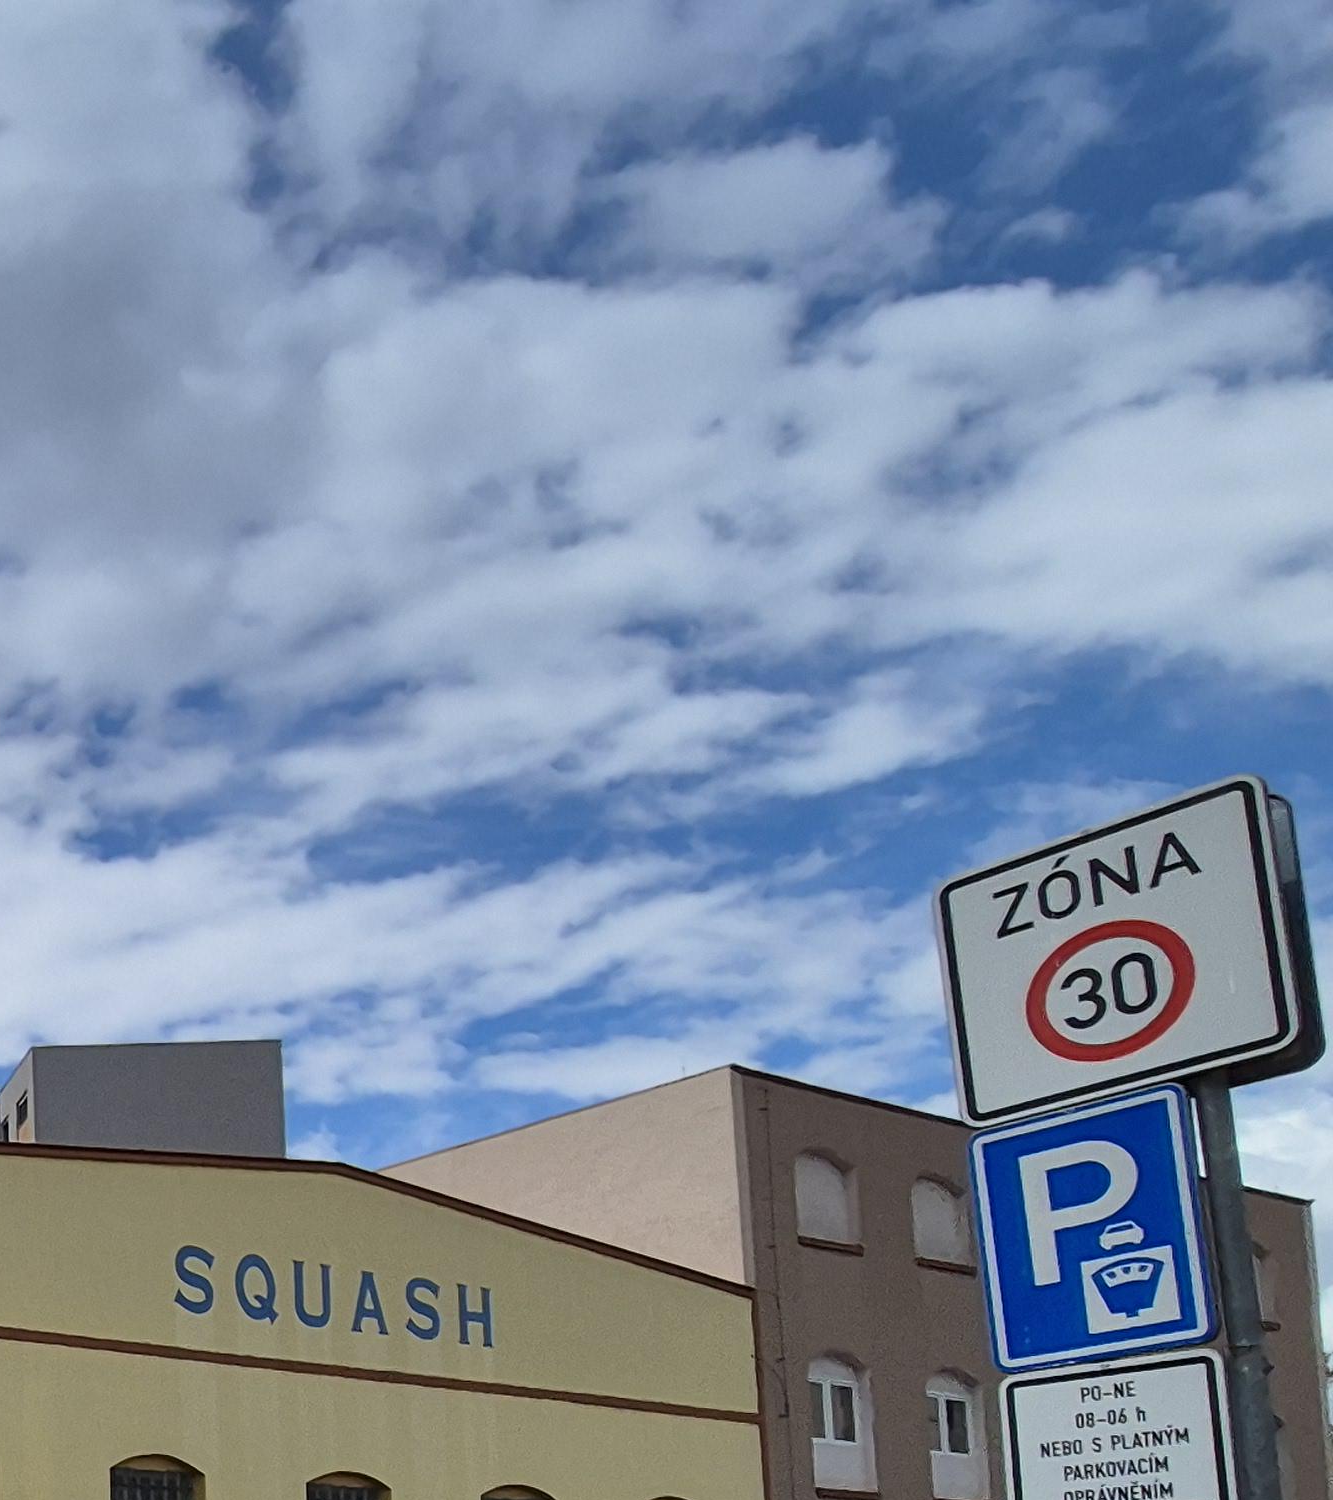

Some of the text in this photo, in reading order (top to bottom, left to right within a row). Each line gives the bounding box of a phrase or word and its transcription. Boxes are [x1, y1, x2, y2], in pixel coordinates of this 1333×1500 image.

[992, 832, 1202, 940] ZÓNA
[1060, 952, 1158, 1030] 30
[1017, 1139, 1139, 1287] P
[173, 1244, 495, 1349] SQUASH
[1074, 1406, 1147, 1429] 08-06 h
[1080, 1381, 1137, 1403] PO-NE
[1040, 1425, 1190, 1458] NEBO S PLATNÝM
[1063, 1453, 1170, 1482] PARKOVACÍM
